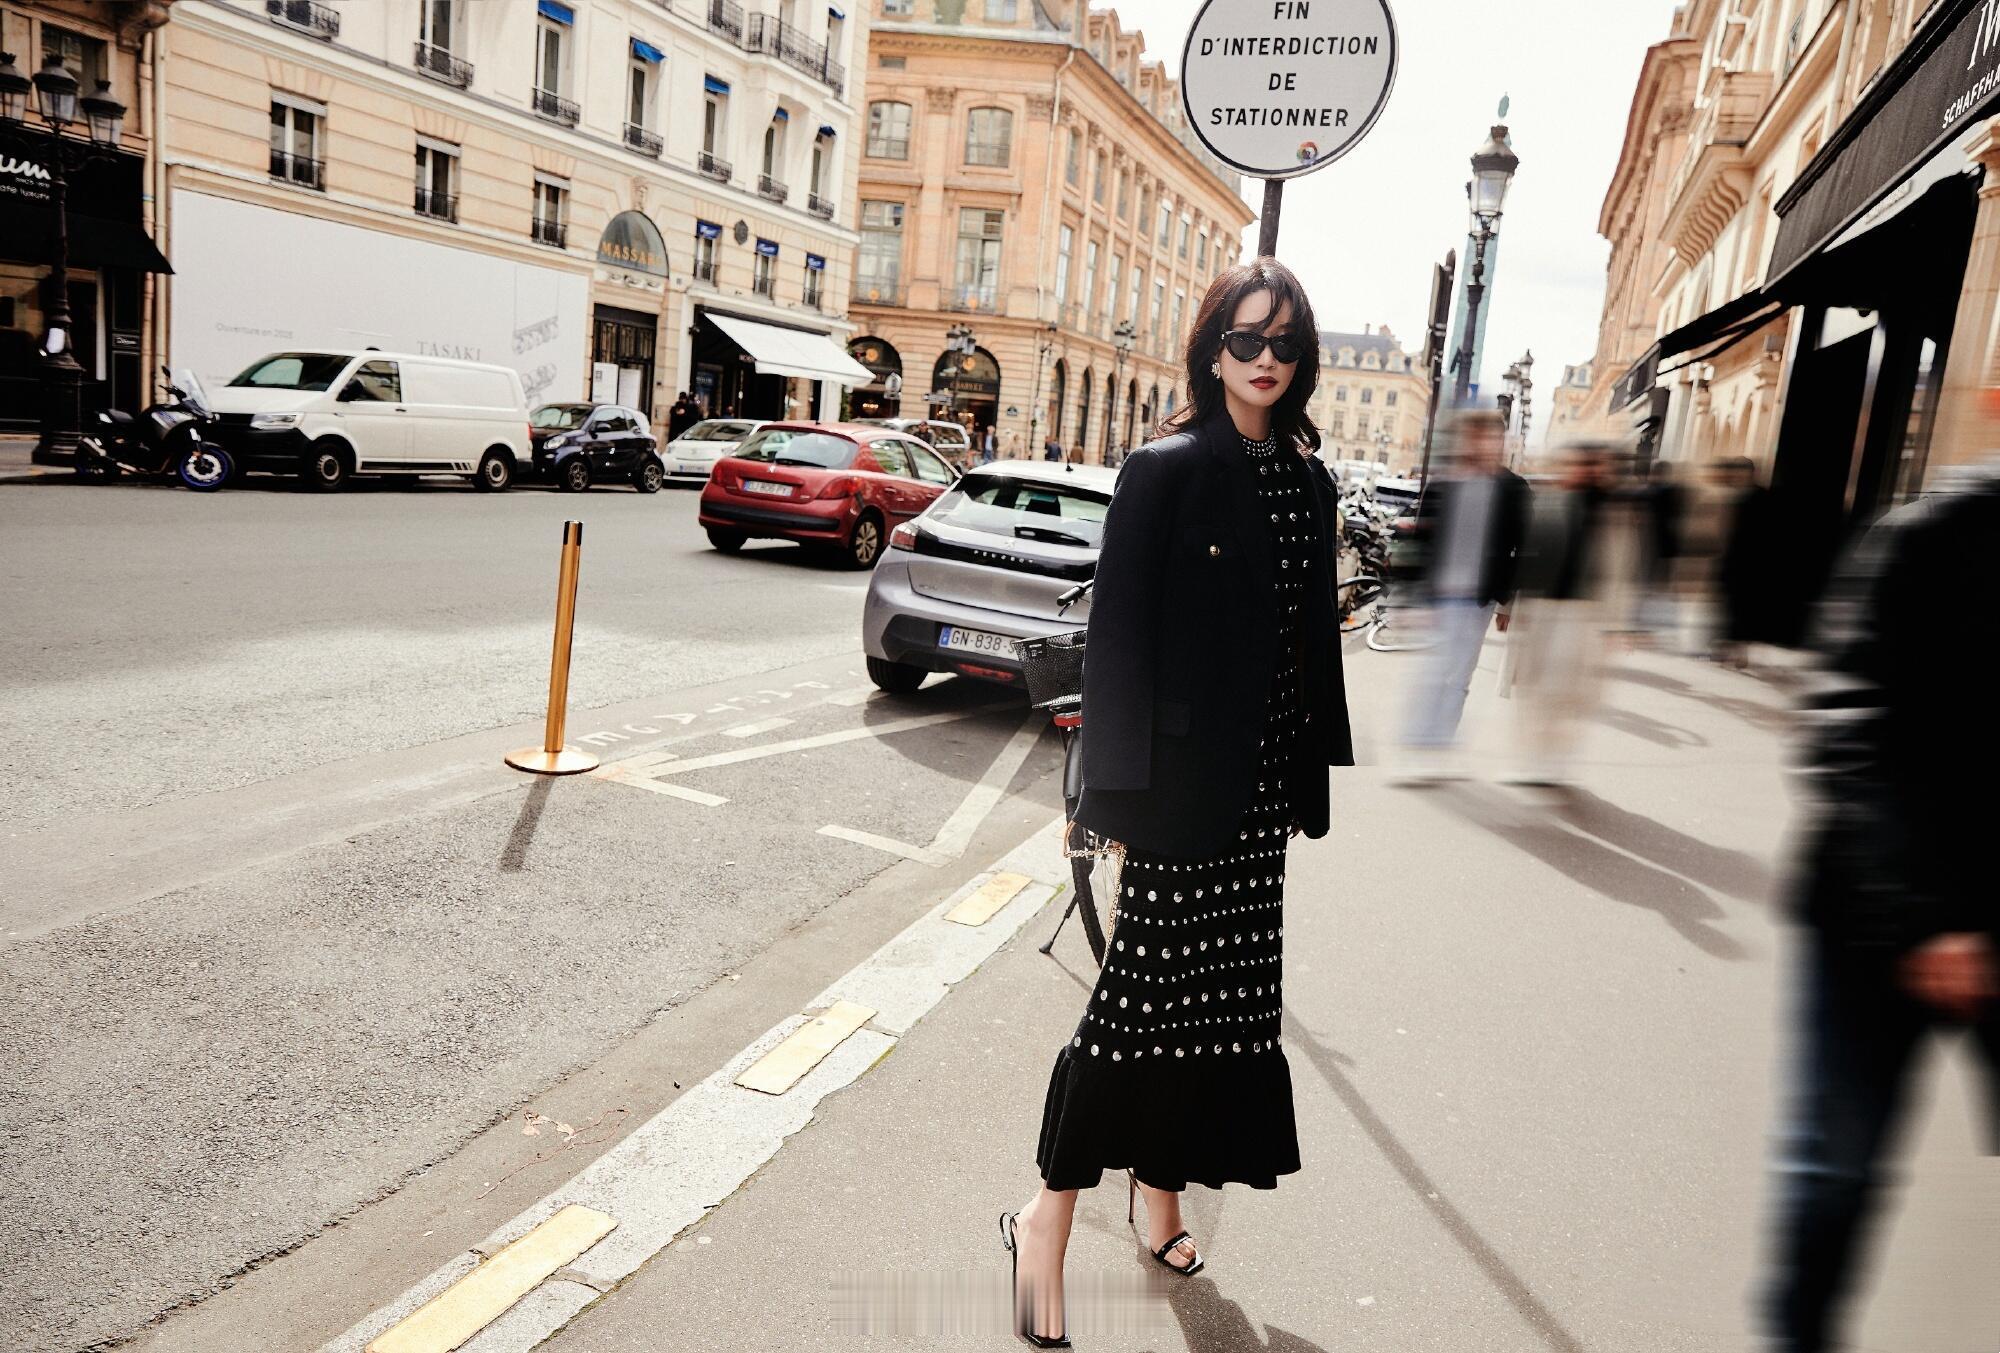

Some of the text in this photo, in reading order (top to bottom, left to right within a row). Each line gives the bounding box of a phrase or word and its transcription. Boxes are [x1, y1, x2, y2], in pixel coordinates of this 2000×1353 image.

[1274, 1, 1310, 20] FIN
[1200, 36, 1378, 56] D'INTERDICTION
[1268, 73, 1297, 91] DE
[1210, 108, 1349, 127] STATIONNER
[600, 241, 663, 268] MASSA
[416, 340, 482, 362] TASAKI
